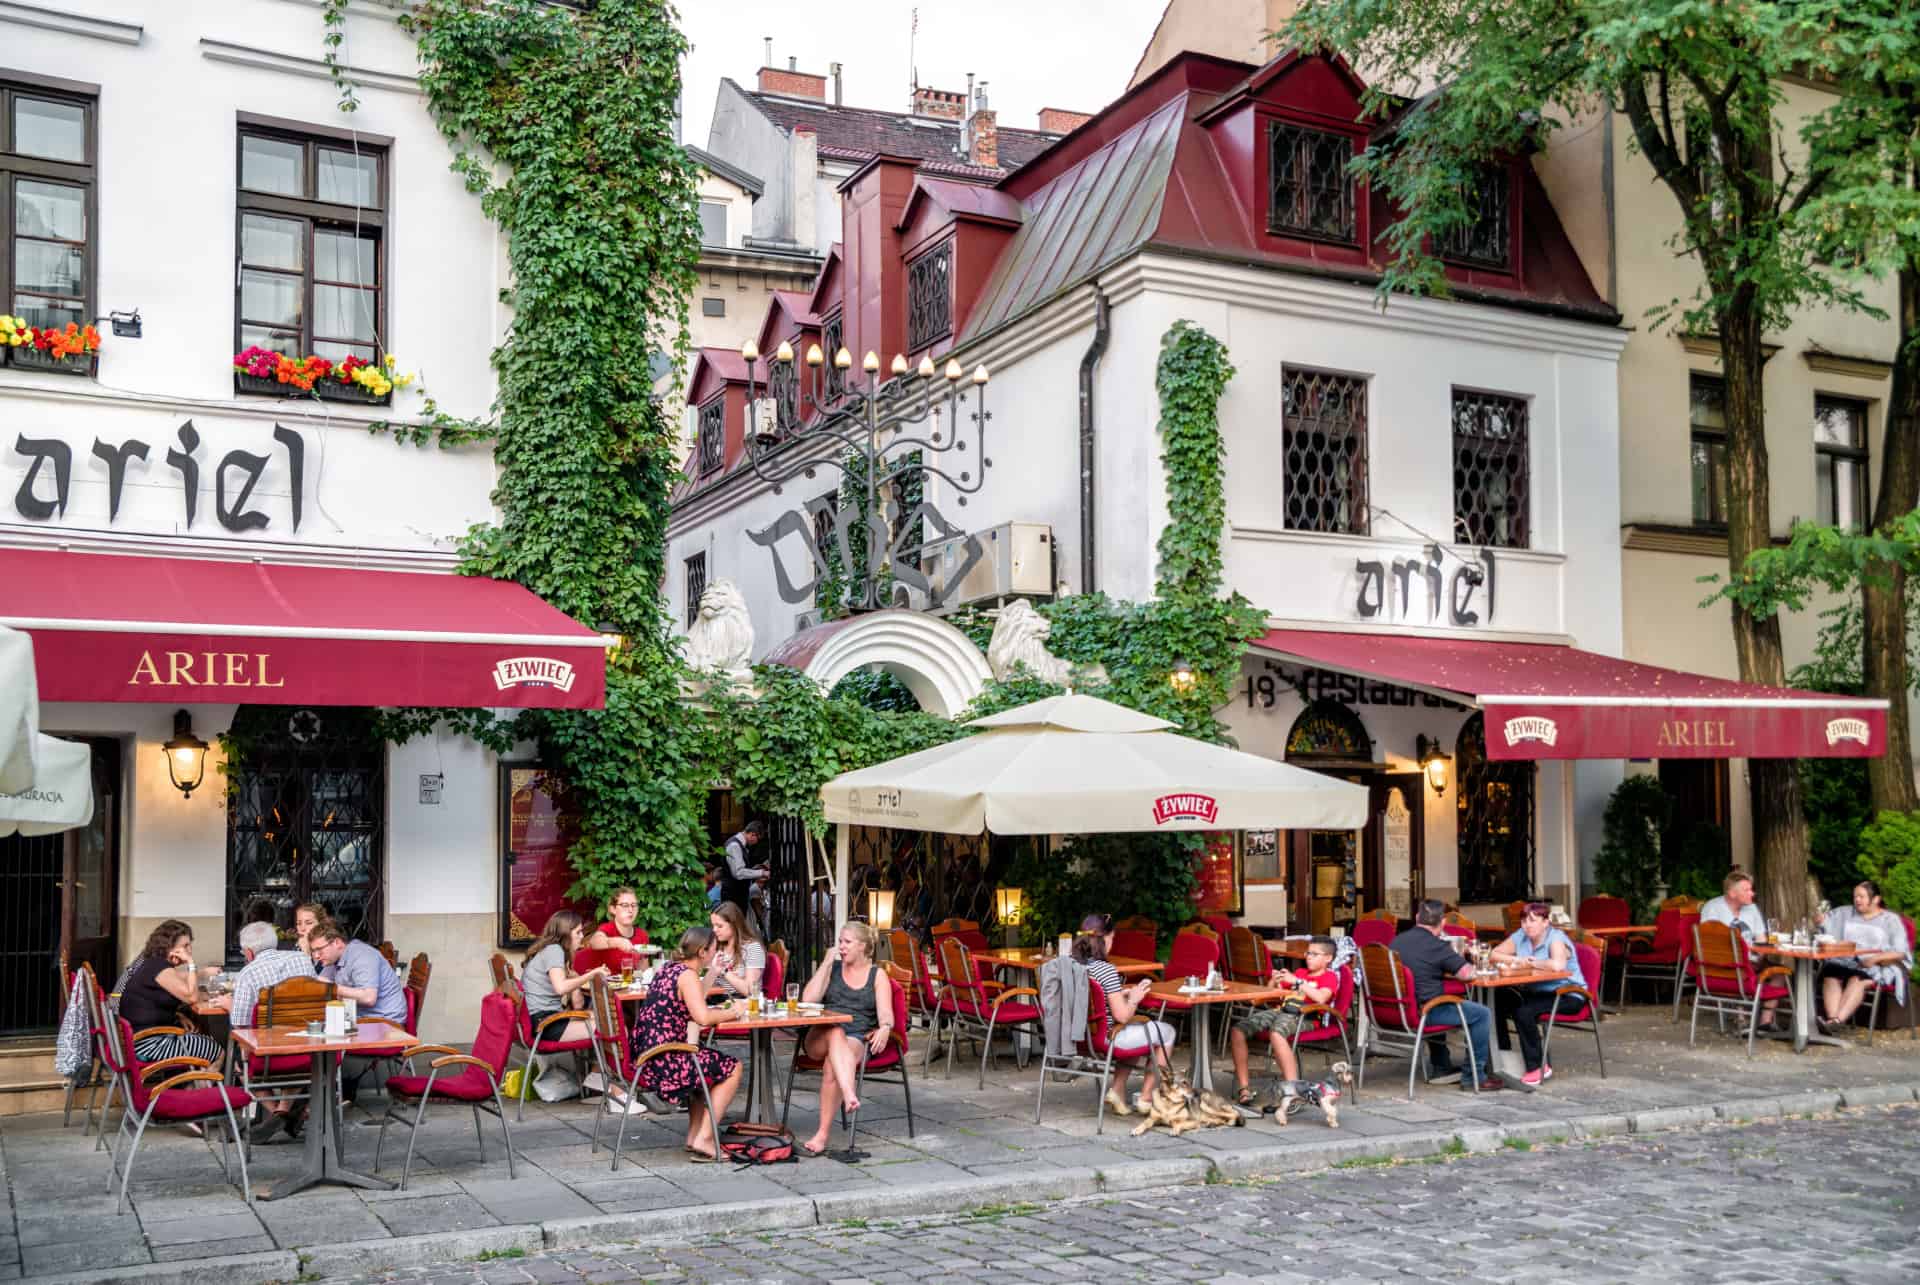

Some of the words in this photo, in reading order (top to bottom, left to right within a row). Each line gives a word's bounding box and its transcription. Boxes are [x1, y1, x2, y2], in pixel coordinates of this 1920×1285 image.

[15, 419, 304, 534] ariel
[1355, 542, 1496, 625] ariel
[128, 650, 285, 688] ARIEL
[503, 660, 566, 681] ŻYWIEC
[1511, 718, 1550, 736] ŻYWIEC
[1657, 720, 1735, 747] ARIEL
[1160, 796, 1212, 815] ŻYWIEC
